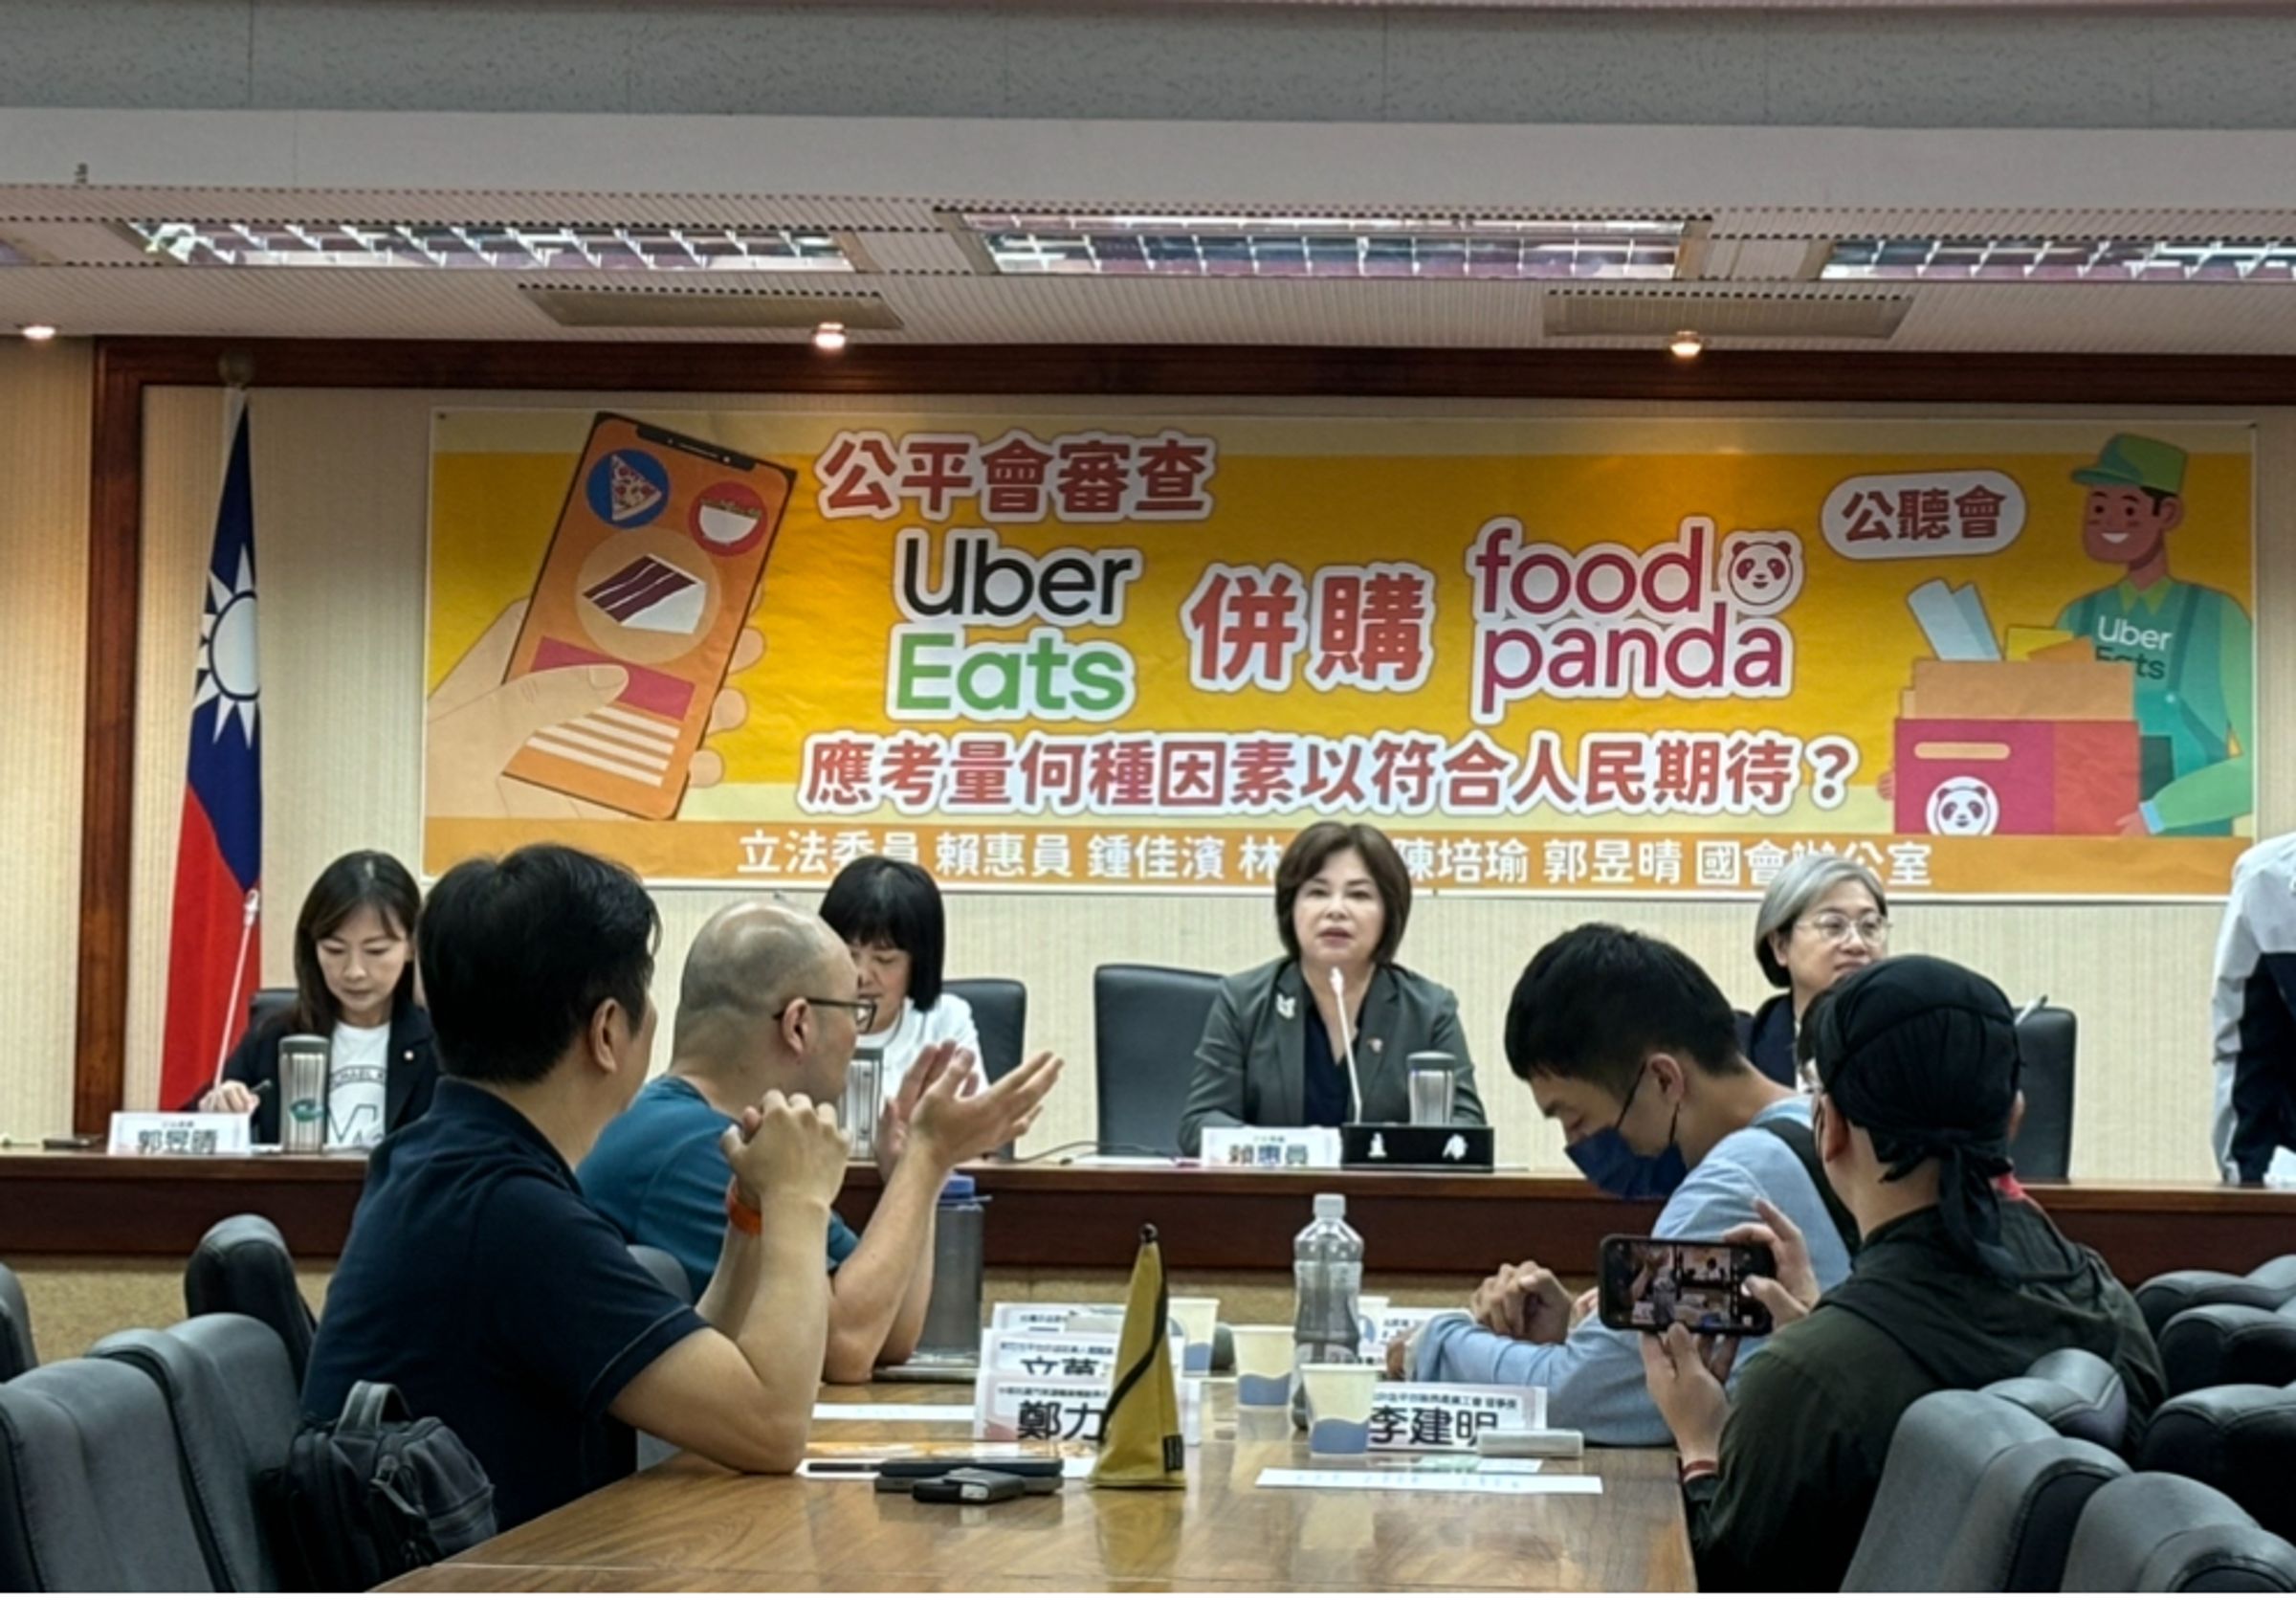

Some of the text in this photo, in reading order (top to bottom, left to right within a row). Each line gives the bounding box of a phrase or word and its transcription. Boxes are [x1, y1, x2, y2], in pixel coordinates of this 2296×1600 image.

[823, 437, 1209, 514] 公平會審查
[1842, 484, 2006, 543] 公聽會
[903, 538, 1134, 616] Uber
[1475, 525, 1705, 615] food
[1191, 574, 1430, 682] 併購
[1479, 601, 1782, 714] panda
[2095, 644, 2166, 680] Ets
[2098, 615, 2173, 652] Uber
[895, 633, 1127, 712] Eats
[806, 739, 1851, 808] 應考量何種因素以符合人民期待？
[935, 832, 1071, 879] 賴惠員
[1543, 838, 1684, 886] 郭昱晴
